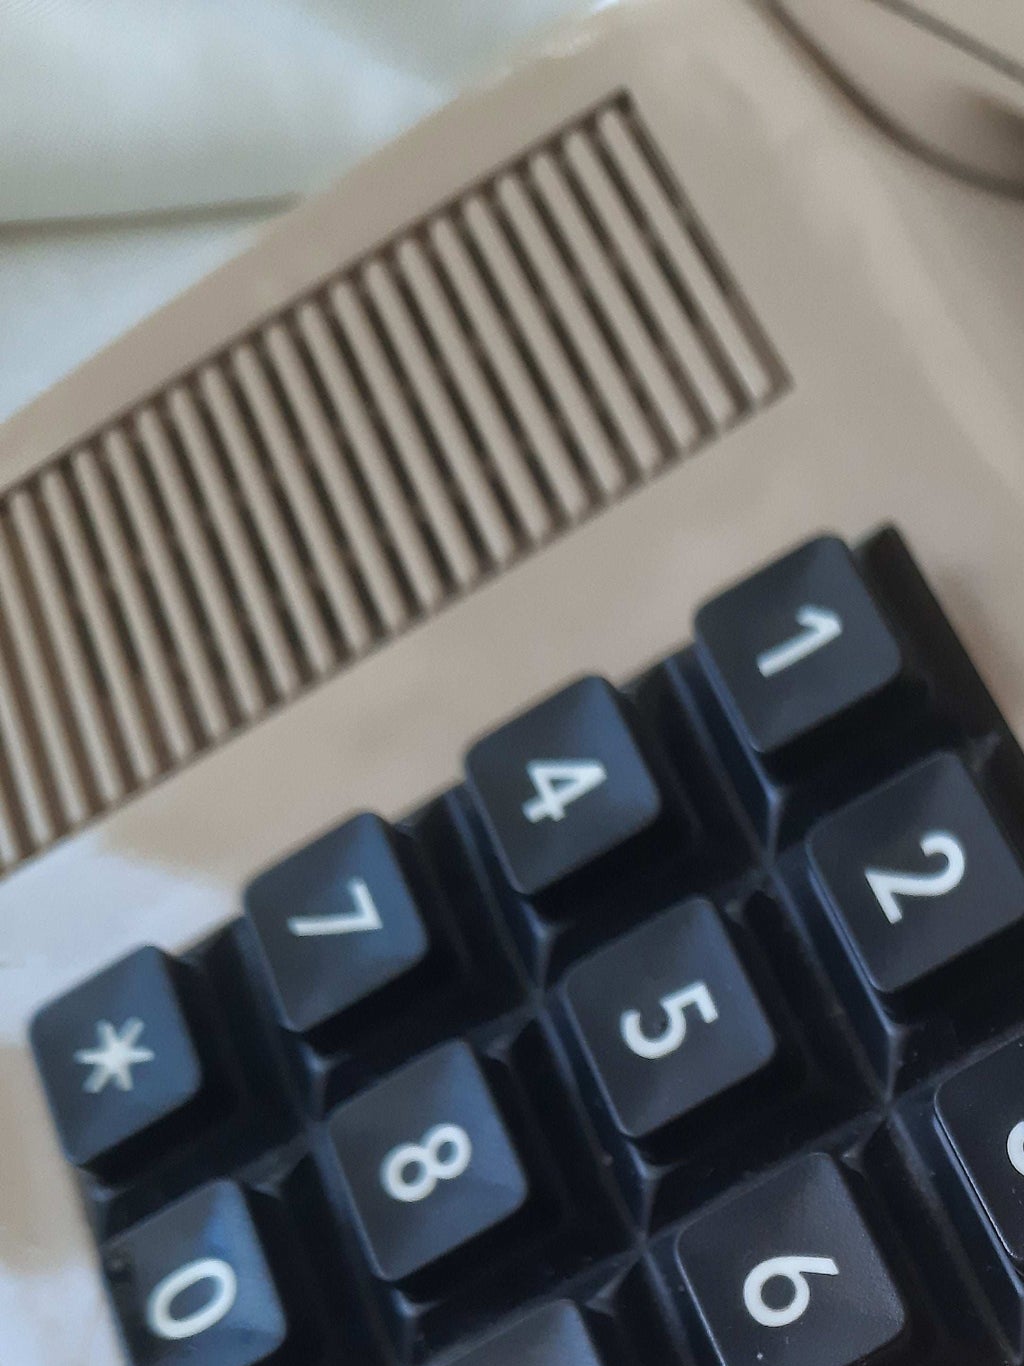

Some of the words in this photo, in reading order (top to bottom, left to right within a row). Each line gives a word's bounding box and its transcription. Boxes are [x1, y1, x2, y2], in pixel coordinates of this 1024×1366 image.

[757, 604, 843, 678] 1
[521, 757, 607, 823] 4
[287, 876, 383, 938] 7
[864, 831, 967, 924] 2
[620, 981, 719, 1061] 5
[382, 1123, 472, 1204] 8
[147, 1256, 238, 1340] 0
[741, 1254, 840, 1329] 6
